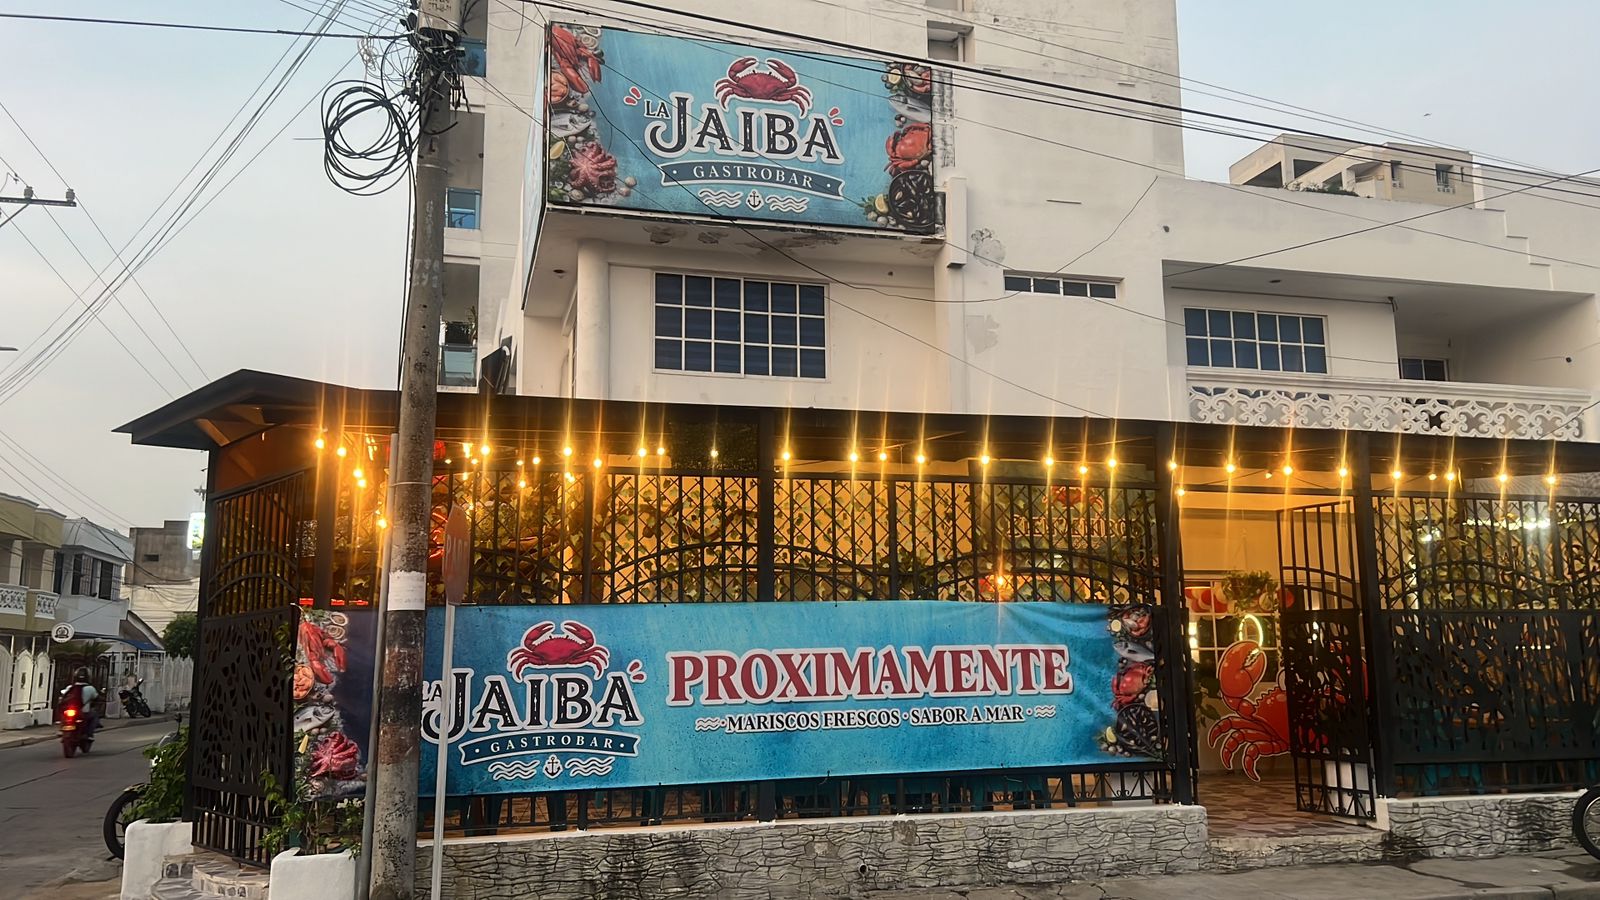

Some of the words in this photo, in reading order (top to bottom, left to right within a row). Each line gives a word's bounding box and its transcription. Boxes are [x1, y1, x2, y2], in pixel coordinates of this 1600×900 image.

[646, 101, 670, 118] LA
[650, 96, 840, 160] JAIBA
[693, 165, 813, 189] GASTROBAR
[669, 648, 1071, 702] PROXIMAMENTE
[422, 672, 640, 740] JAIBA
[727, 713, 819, 732] MARISCOS
[824, 710, 900, 727] FRESCOS
[911, 708, 967, 724] SABOR
[971, 707, 983, 722] A
[985, 706, 1024, 722] MAR
[490, 734, 613, 753] GASTROBAR
